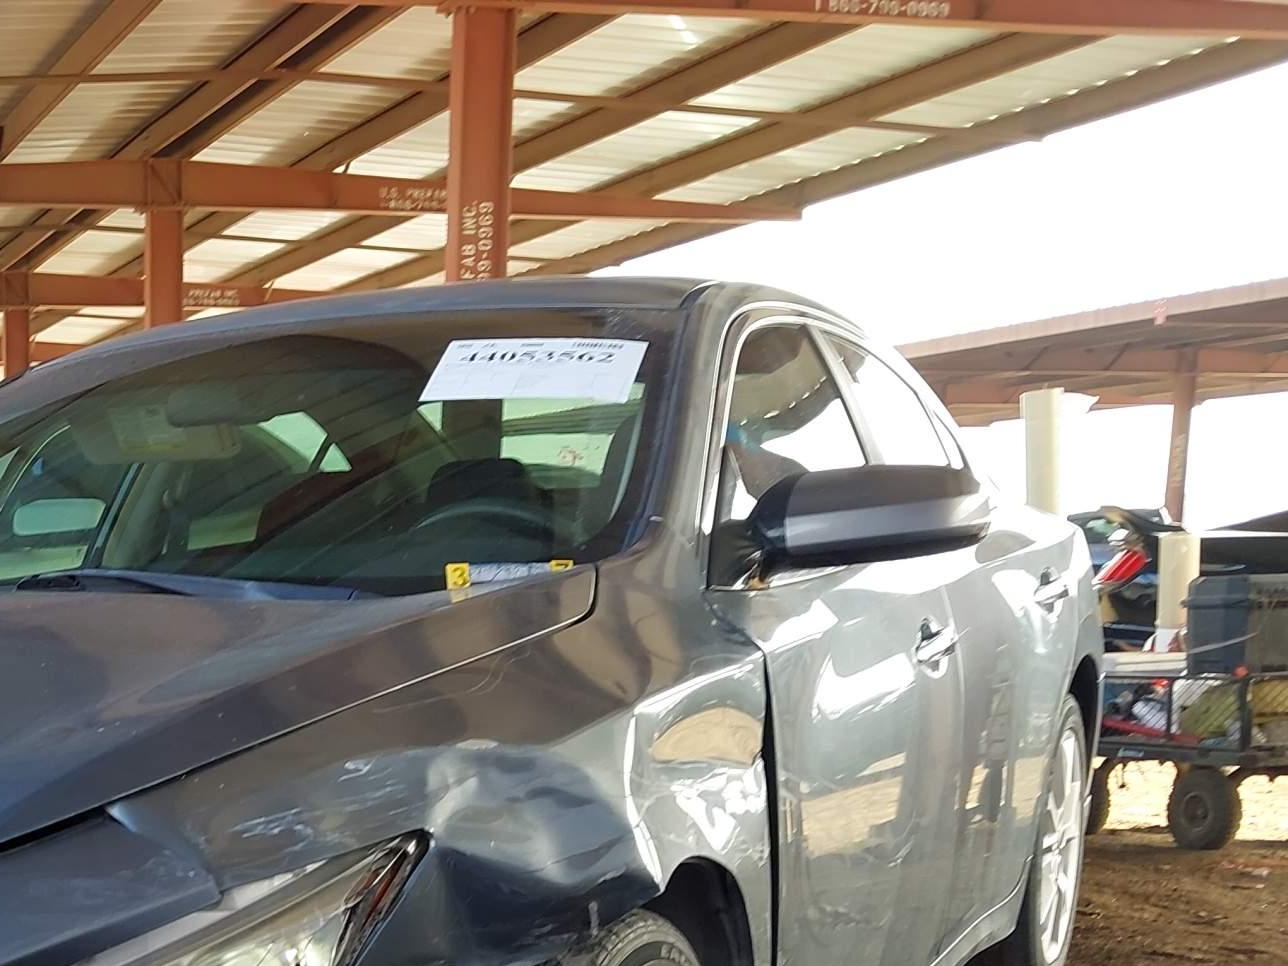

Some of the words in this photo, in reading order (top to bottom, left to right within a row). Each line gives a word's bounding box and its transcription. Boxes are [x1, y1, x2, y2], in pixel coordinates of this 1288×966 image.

[462, 199, 479, 235] INC.
[459, 350, 617, 364] 44053562
[451, 566, 467, 587] 3
